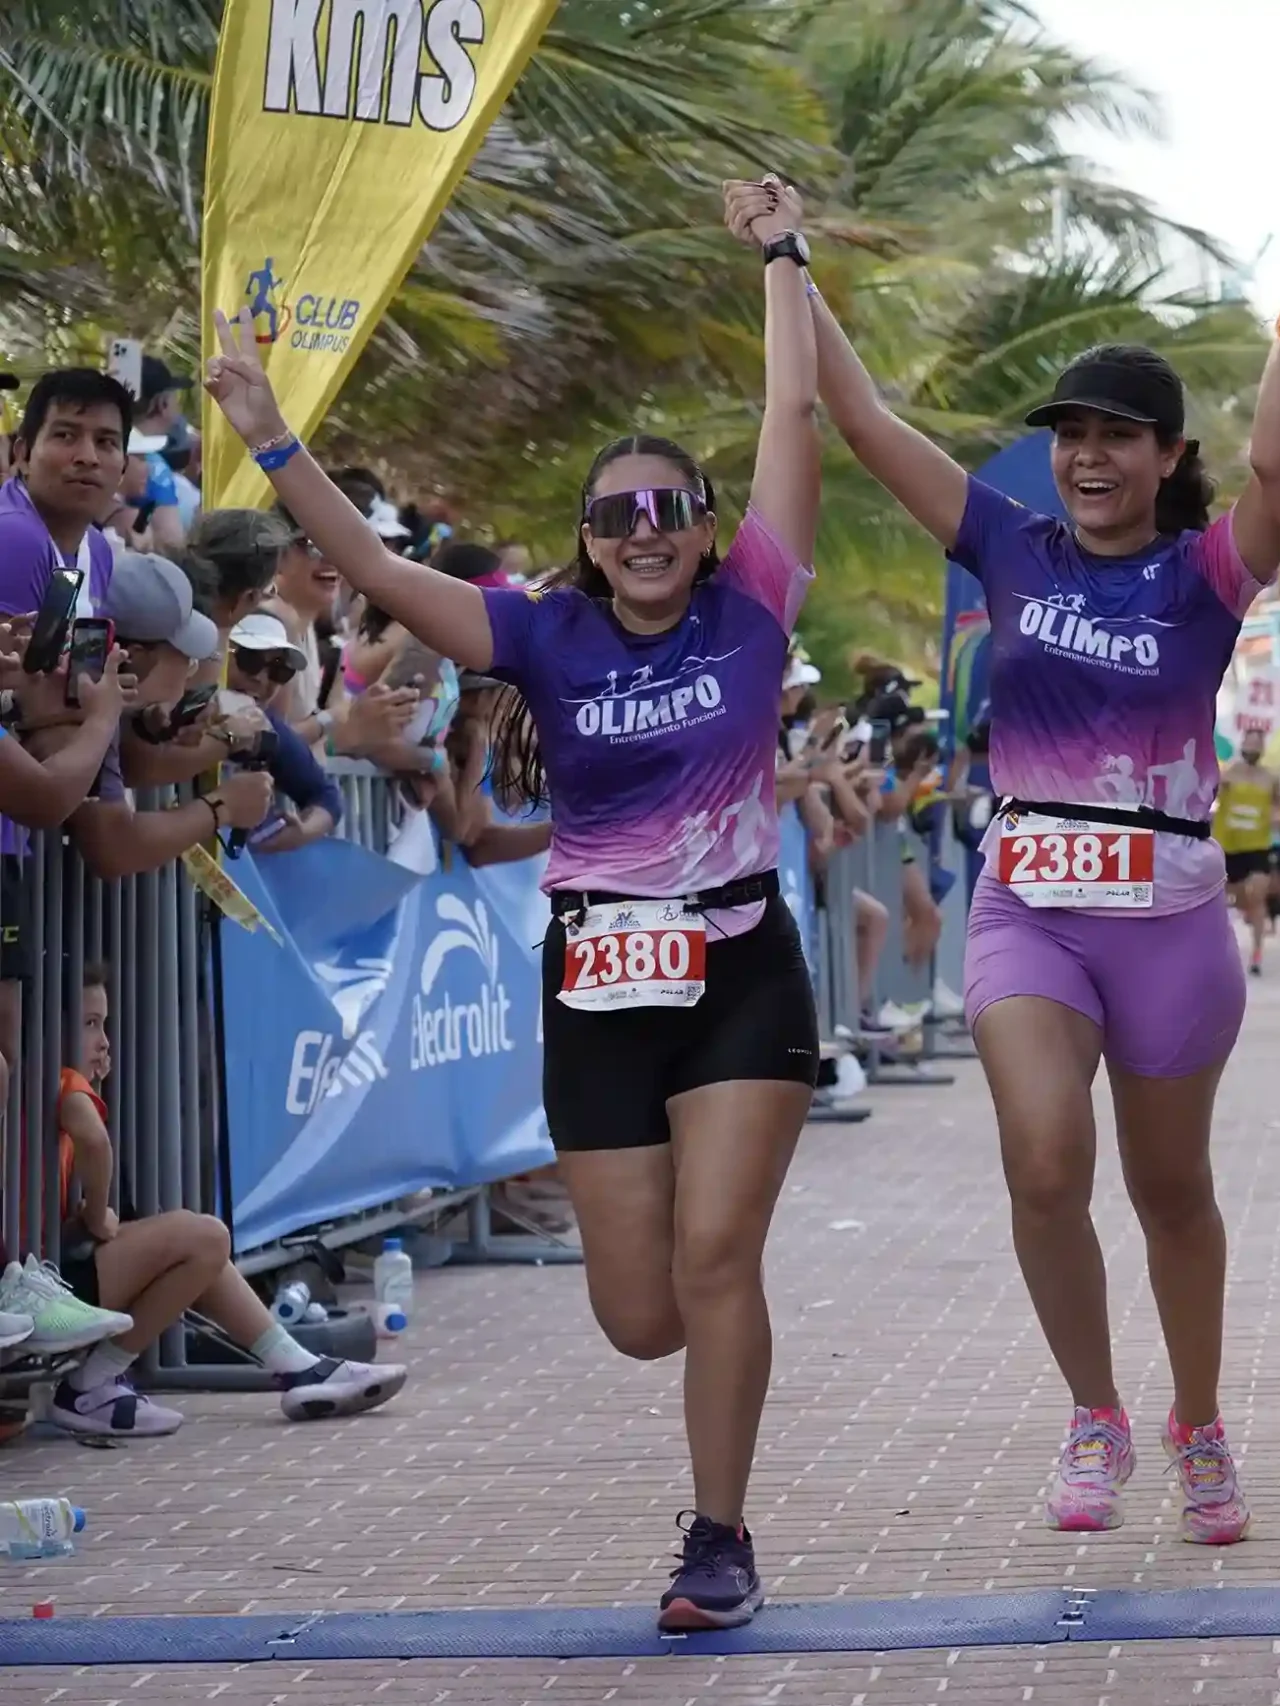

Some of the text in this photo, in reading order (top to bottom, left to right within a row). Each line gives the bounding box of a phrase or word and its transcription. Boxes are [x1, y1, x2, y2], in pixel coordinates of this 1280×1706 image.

[262, 0, 484, 132] kms
[296, 294, 360, 330] CLUB
[291, 330, 350, 353] OLIMPUS
[1019, 602, 1160, 667] OLIMPO
[1044, 644, 1160, 676] Entrenamiento Funcional
[576, 674, 721, 736] OLIMPO
[610, 705, 727, 744] Entrenamiento Funcional
[1009, 834, 1131, 883] 2381
[1105, 889, 1130, 897] POLAR
[574, 931, 690, 989] 2380
[660, 987, 684, 995] POLAR
[411, 984, 515, 1070] Electrolit
